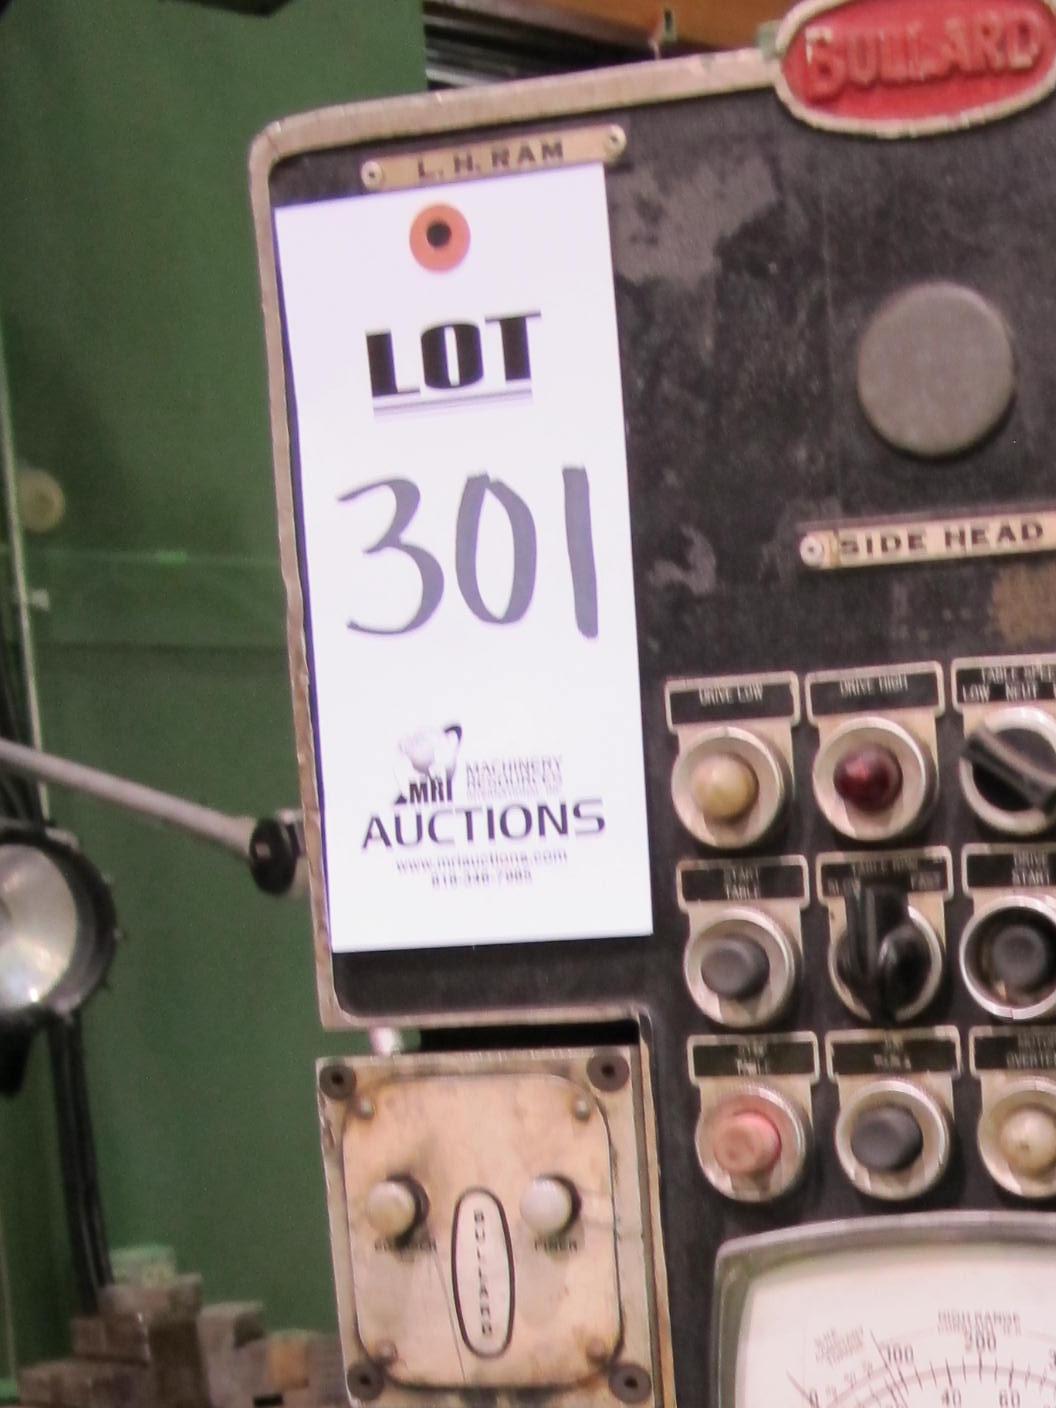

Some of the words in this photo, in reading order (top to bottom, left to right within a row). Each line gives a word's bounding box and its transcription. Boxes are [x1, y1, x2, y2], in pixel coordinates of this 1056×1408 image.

[803, 8, 1044, 102] BULLARD
[490, 140, 564, 168] RAM
[365, 311, 542, 398] LOT
[337, 465, 600, 640] 301
[838, 530, 928, 555] SIDE
[943, 520, 1045, 549] HEAD
[961, 683, 990, 703] LOW
[360, 797, 607, 850] AUCTIONS
[940, 1388, 963, 1408] 40
